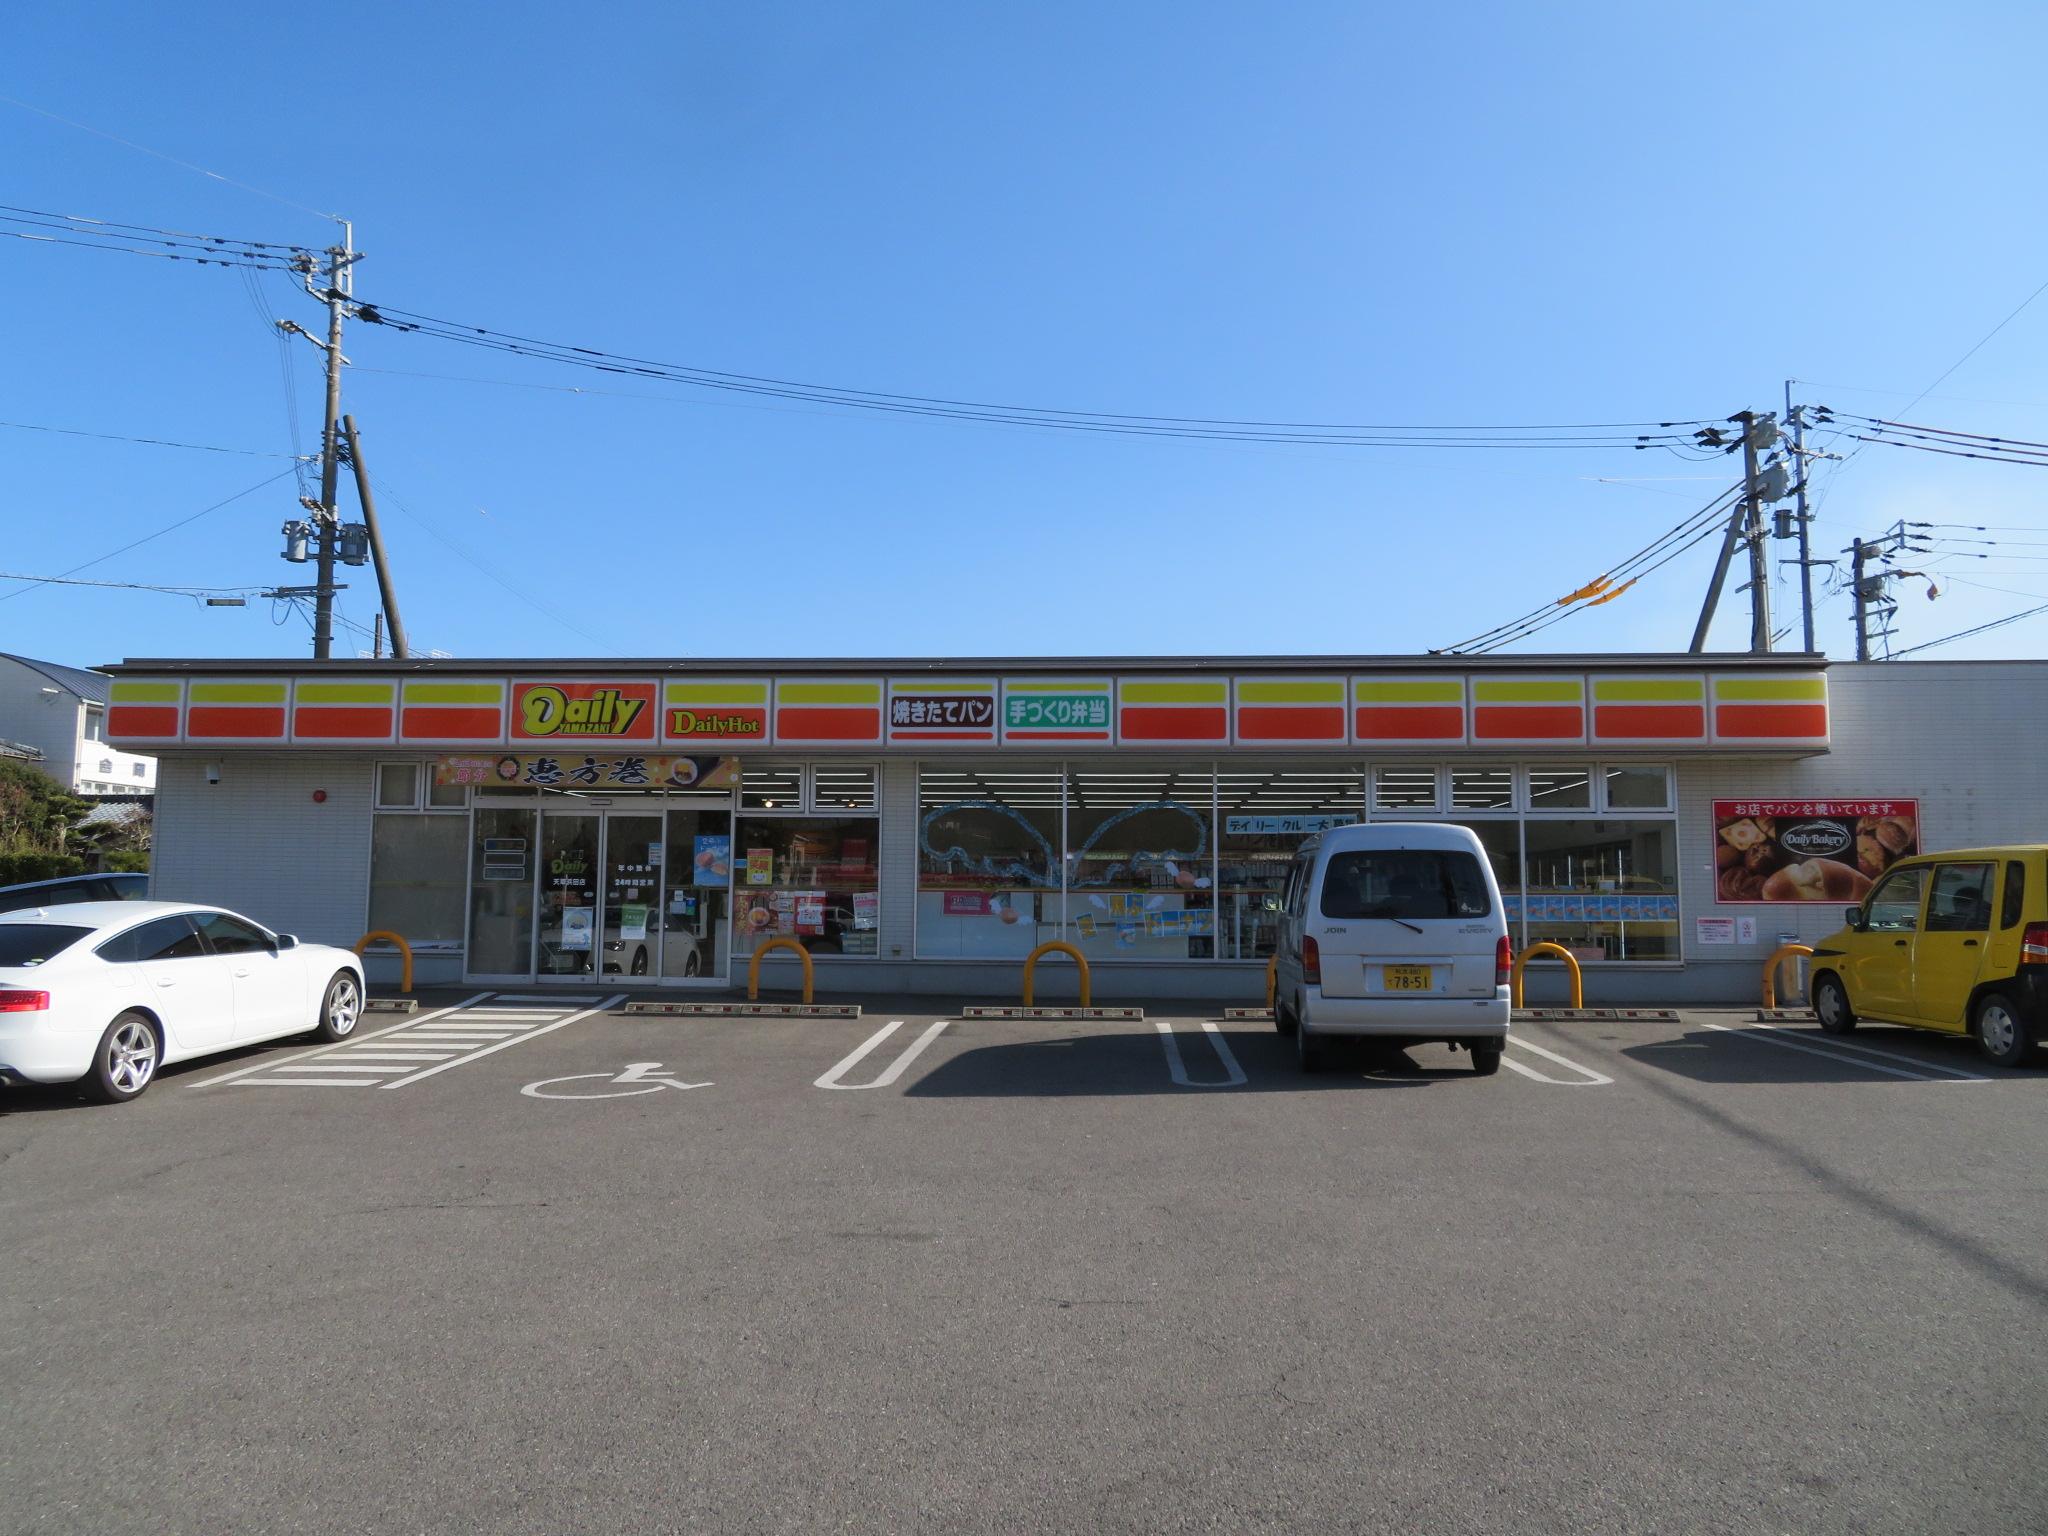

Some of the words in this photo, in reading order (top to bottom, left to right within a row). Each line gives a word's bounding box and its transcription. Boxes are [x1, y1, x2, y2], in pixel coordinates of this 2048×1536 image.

[522, 687, 645, 735] Daily
[893, 700, 991, 724] 焼きたてパン
[1010, 700, 1105, 723] 手づくり弁当
[560, 723, 610, 733] YAMAZAKI
[526, 758, 649, 784] 恵方巻
[1735, 803, 1897, 815] お店でパンを焼いています。
[1786, 834, 1811, 846] Daily
[1812, 834, 1844, 847] Bakery
[552, 860, 588, 874] Daily
[1394, 976, 1428, 989] 78-51
